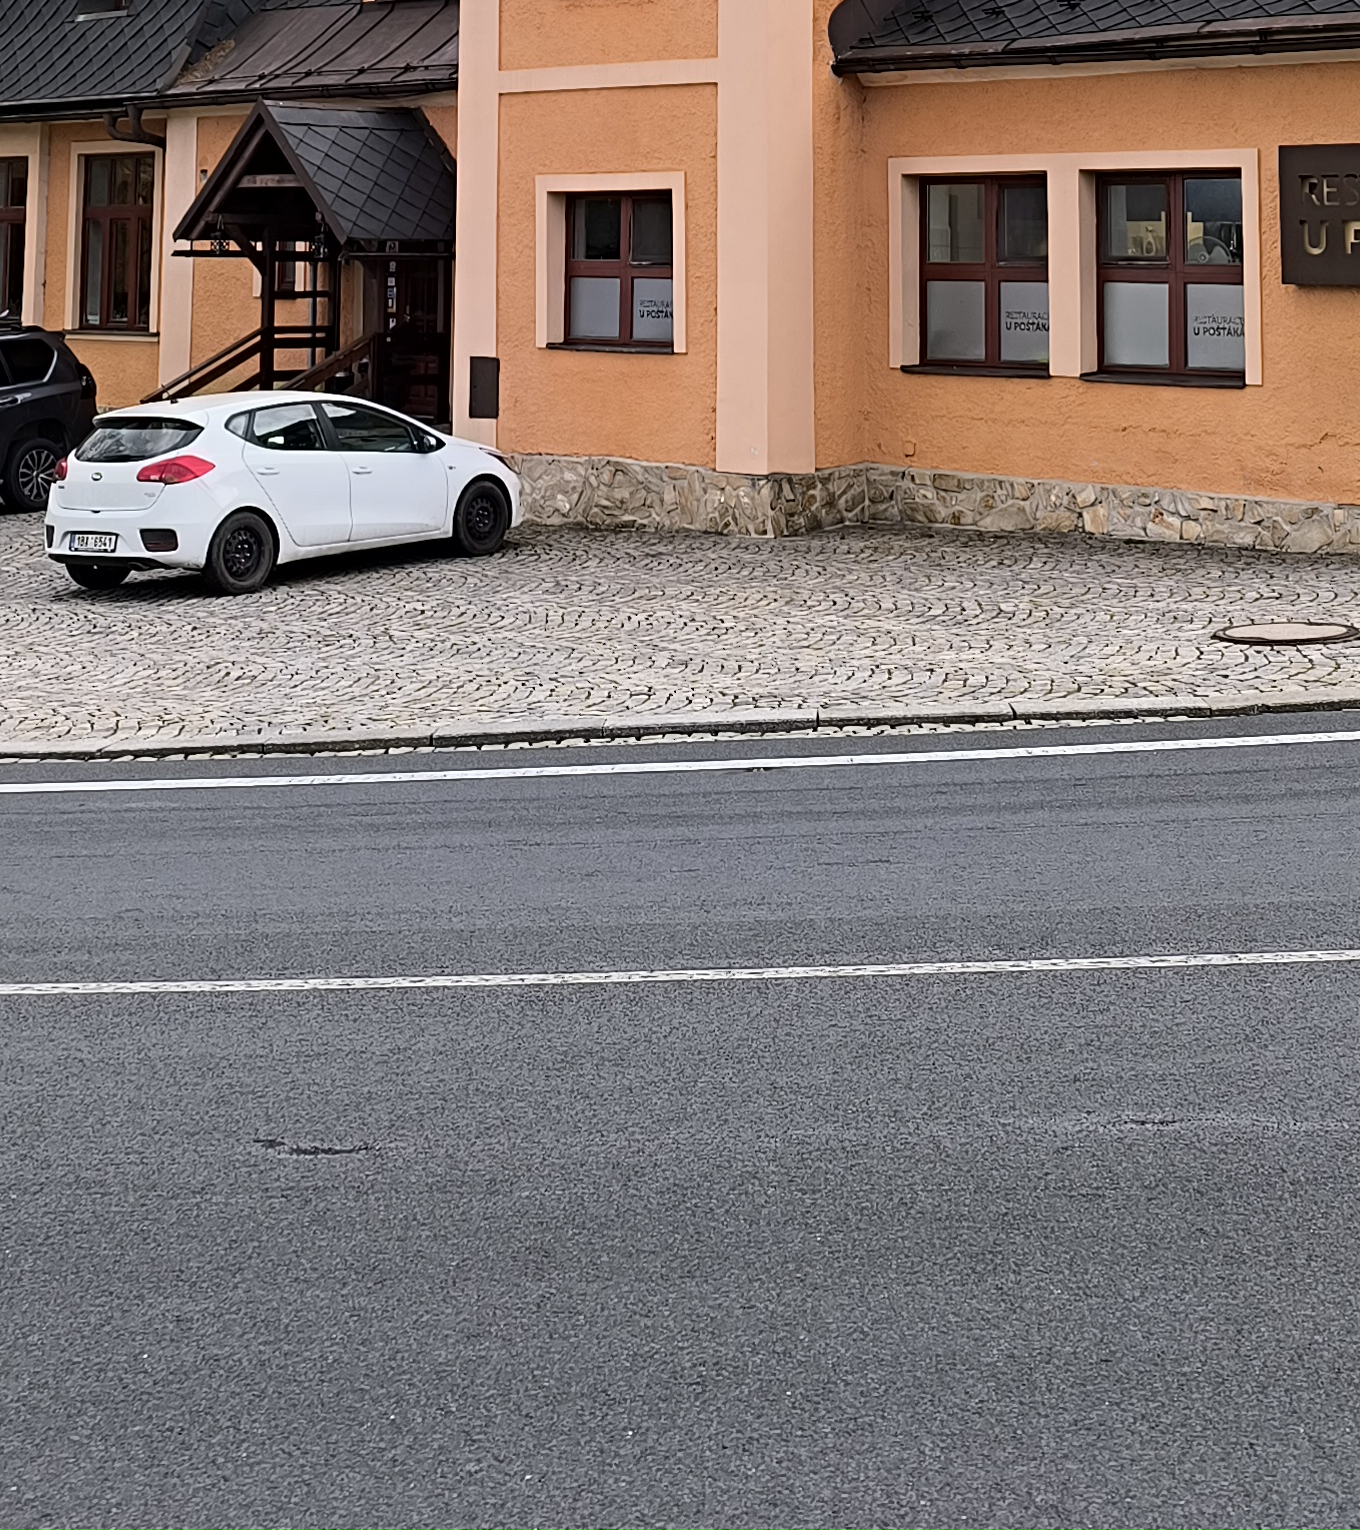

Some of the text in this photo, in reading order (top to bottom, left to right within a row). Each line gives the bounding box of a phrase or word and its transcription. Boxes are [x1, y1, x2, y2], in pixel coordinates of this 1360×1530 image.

[1299, 219, 1328, 255] U
[1005, 321, 1012, 331] U
[1193, 326, 1200, 336] U
